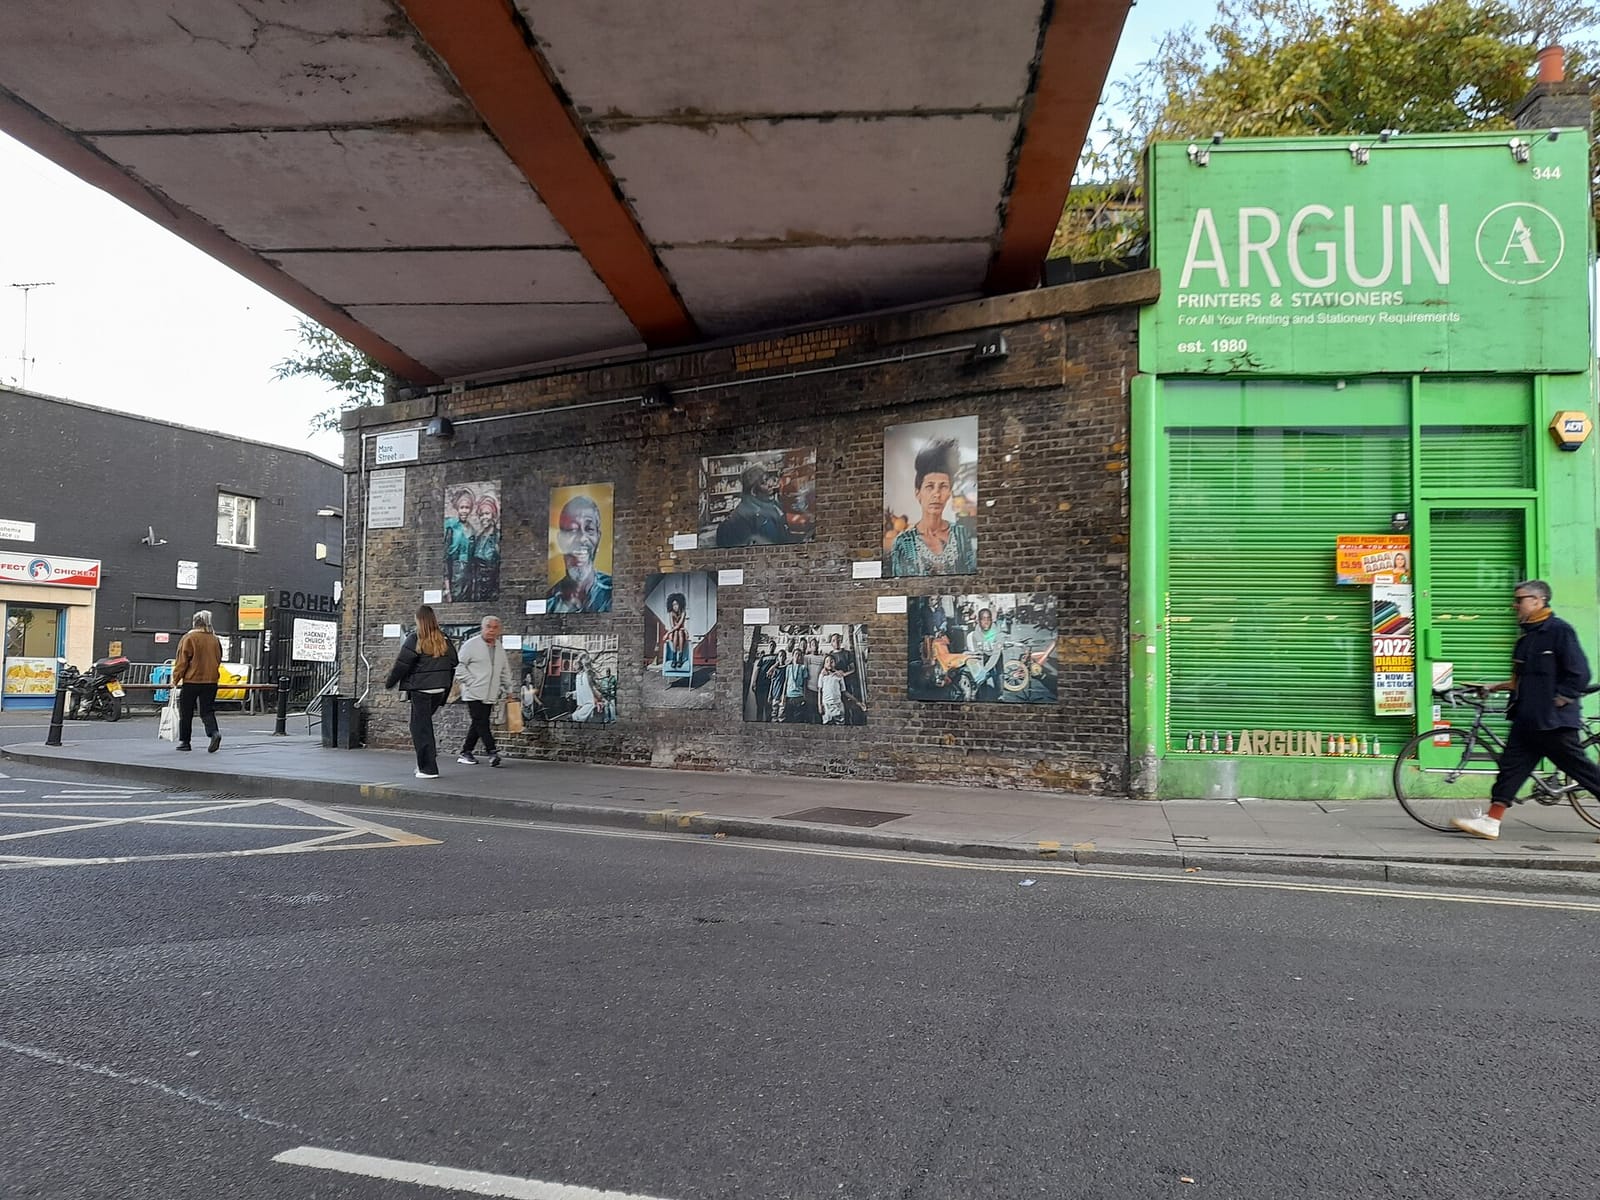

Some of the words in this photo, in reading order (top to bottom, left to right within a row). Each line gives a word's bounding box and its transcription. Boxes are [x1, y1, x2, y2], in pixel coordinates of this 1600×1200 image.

[1532, 166, 1561, 180] 344
[1178, 204, 1450, 289] ARGUN
[1495, 216, 1545, 264] A
[1177, 293, 1261, 308] PRINTERS
[1270, 293, 1283, 307] &
[1291, 291, 1403, 307] STATIONERS
[1178, 314, 1198, 325] For
[1200, 314, 1215, 325] All
[1217, 314, 1243, 325] Your
[1246, 313, 1289, 327] Printing
[1292, 314, 1314, 324] and
[1317, 312, 1376, 325] Stationery
[1379, 312, 1460, 324] Requirements
[1177, 340, 1206, 353] est.
[1211, 339, 1248, 352] 1980
[378, 453, 397, 461] Street
[54, 568, 95, 577] CHICKEN
[1374, 639, 1411, 656] 2022
[1375, 656, 1412, 666] DIARIES
[1238, 730, 1322, 757] ARGUN
